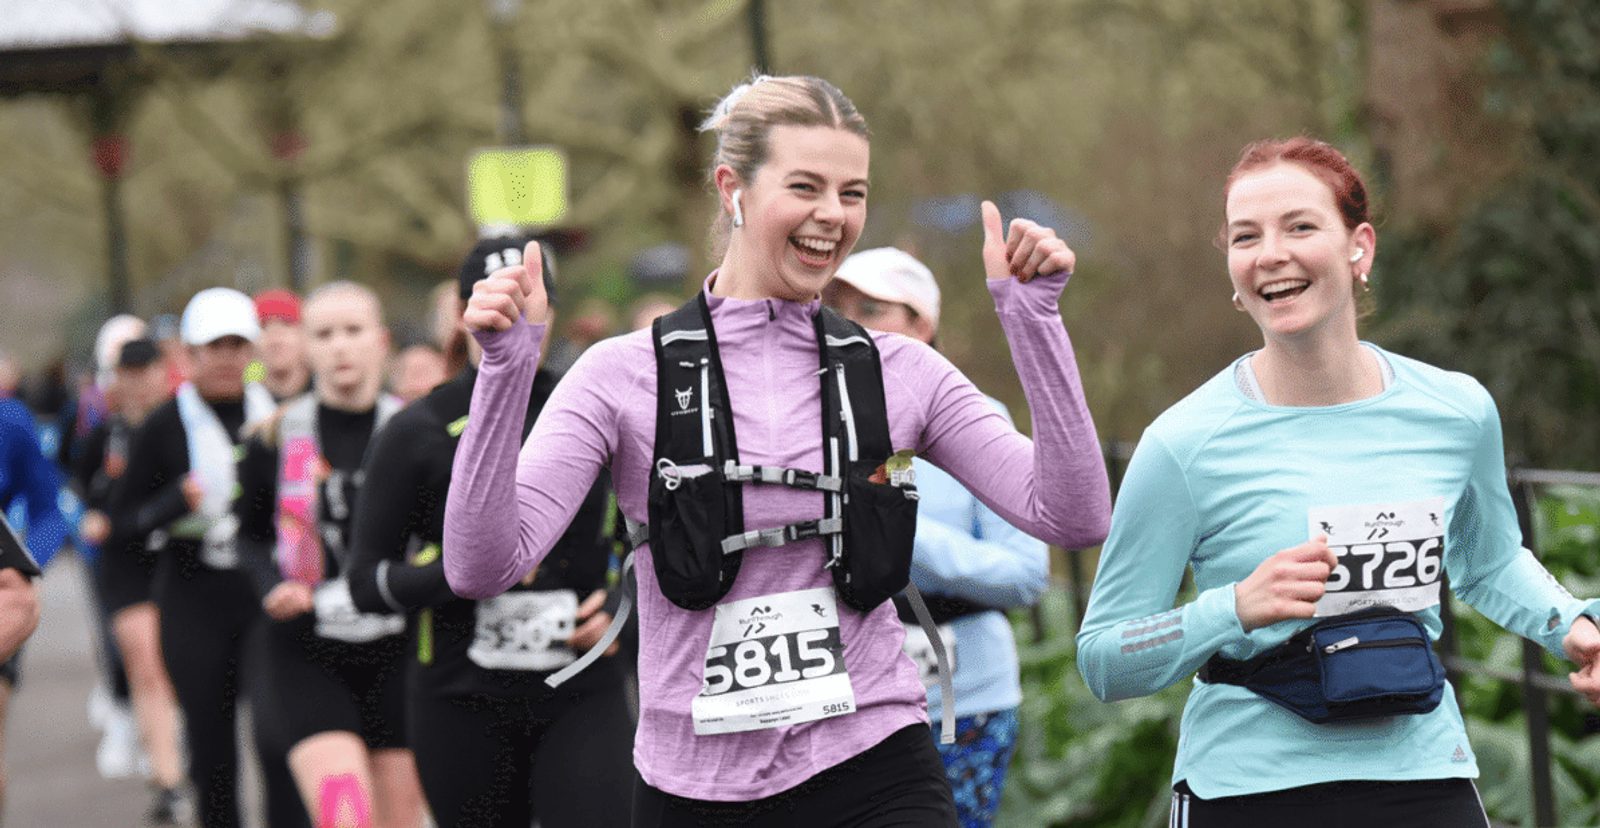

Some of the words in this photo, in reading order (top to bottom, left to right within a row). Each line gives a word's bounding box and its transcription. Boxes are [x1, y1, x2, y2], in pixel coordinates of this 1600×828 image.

[1324, 537, 1440, 592] 5726
[703, 629, 835, 696] 5815
[822, 701, 850, 715] 5815
